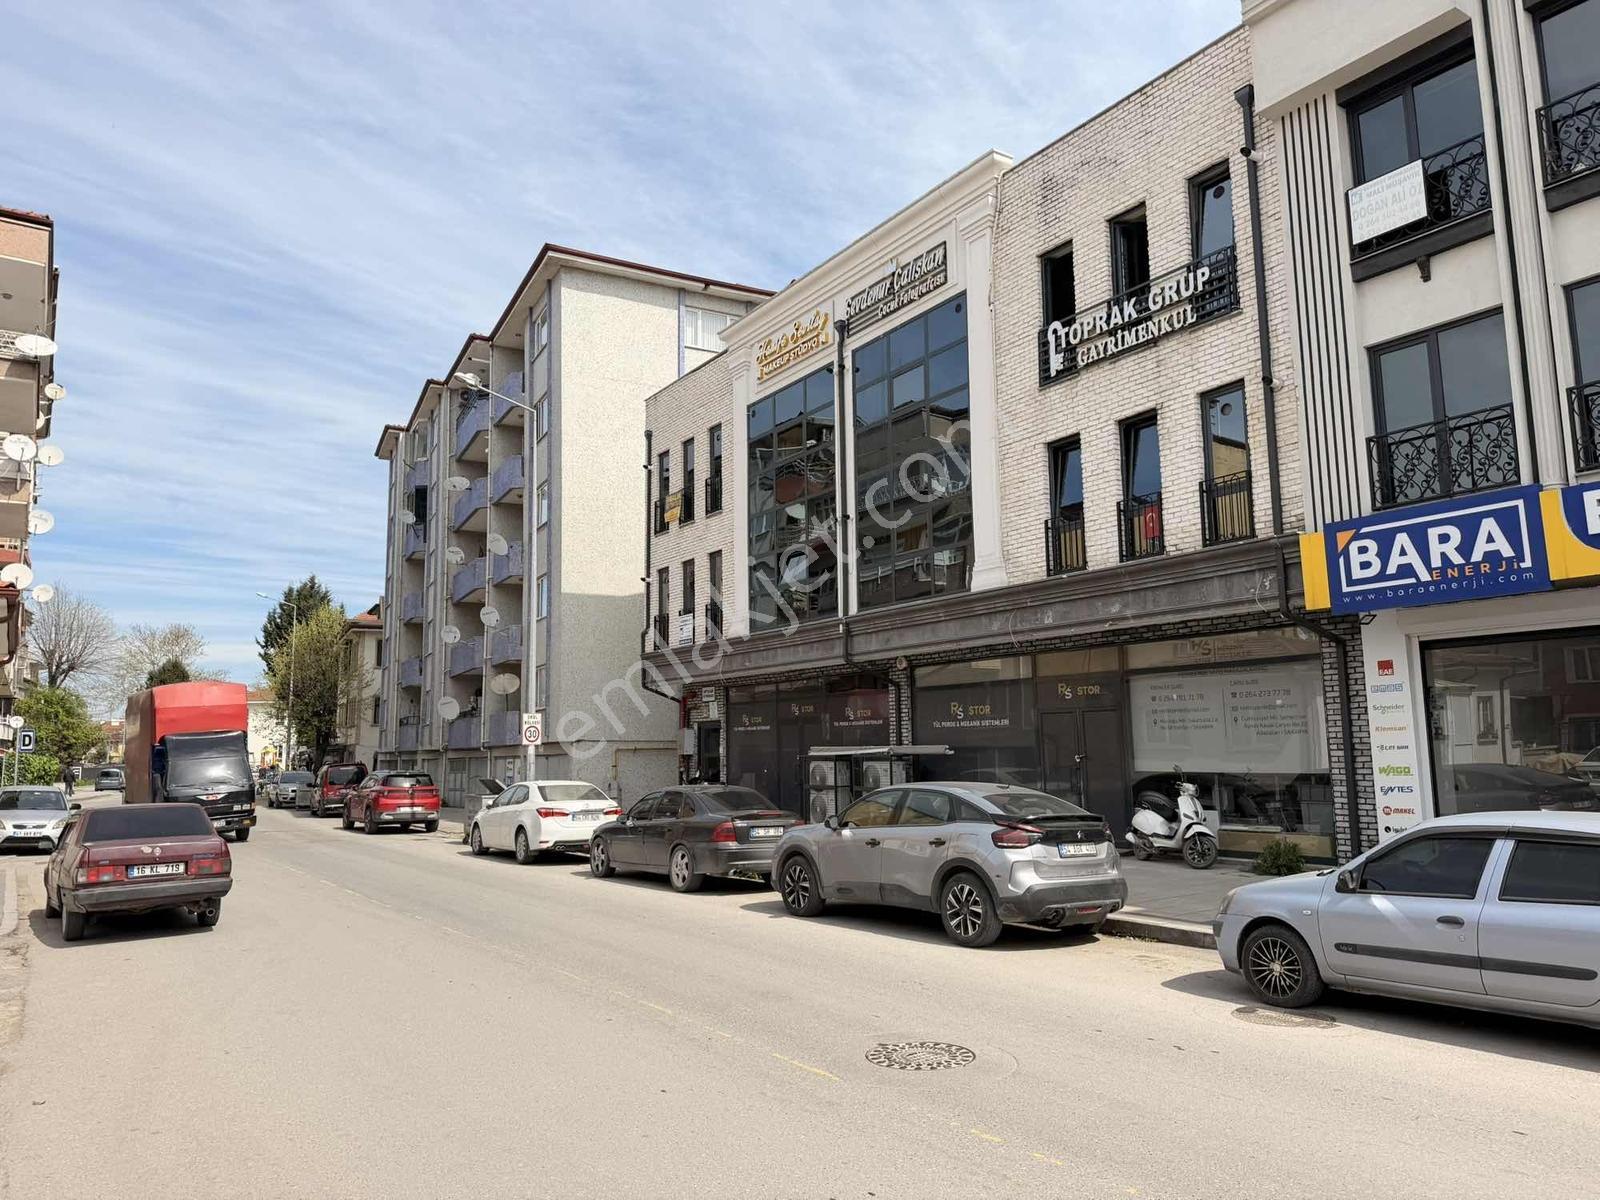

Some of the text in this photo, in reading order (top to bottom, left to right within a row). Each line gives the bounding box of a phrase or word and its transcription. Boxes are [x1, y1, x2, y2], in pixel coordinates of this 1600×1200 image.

[1059, 266, 1210, 349] TOPRAK GRUP
[1076, 304, 1198, 369] GAYRİMENKUL
[763, 352, 790, 375] MAKEUP
[1349, 516, 1516, 583] BARA
[1343, 571, 1534, 604] www.baraenerji.com
[1077, 685, 1100, 696] STOR
[968, 705, 991, 716] STOR
[527, 729, 537, 739] 30
[22, 734, 32, 747] D
[1378, 764, 1411, 776] WAGO
[1380, 785, 1413, 795] ENTES
[136, 867, 146, 876] 16
[150, 865, 160, 874] KL
